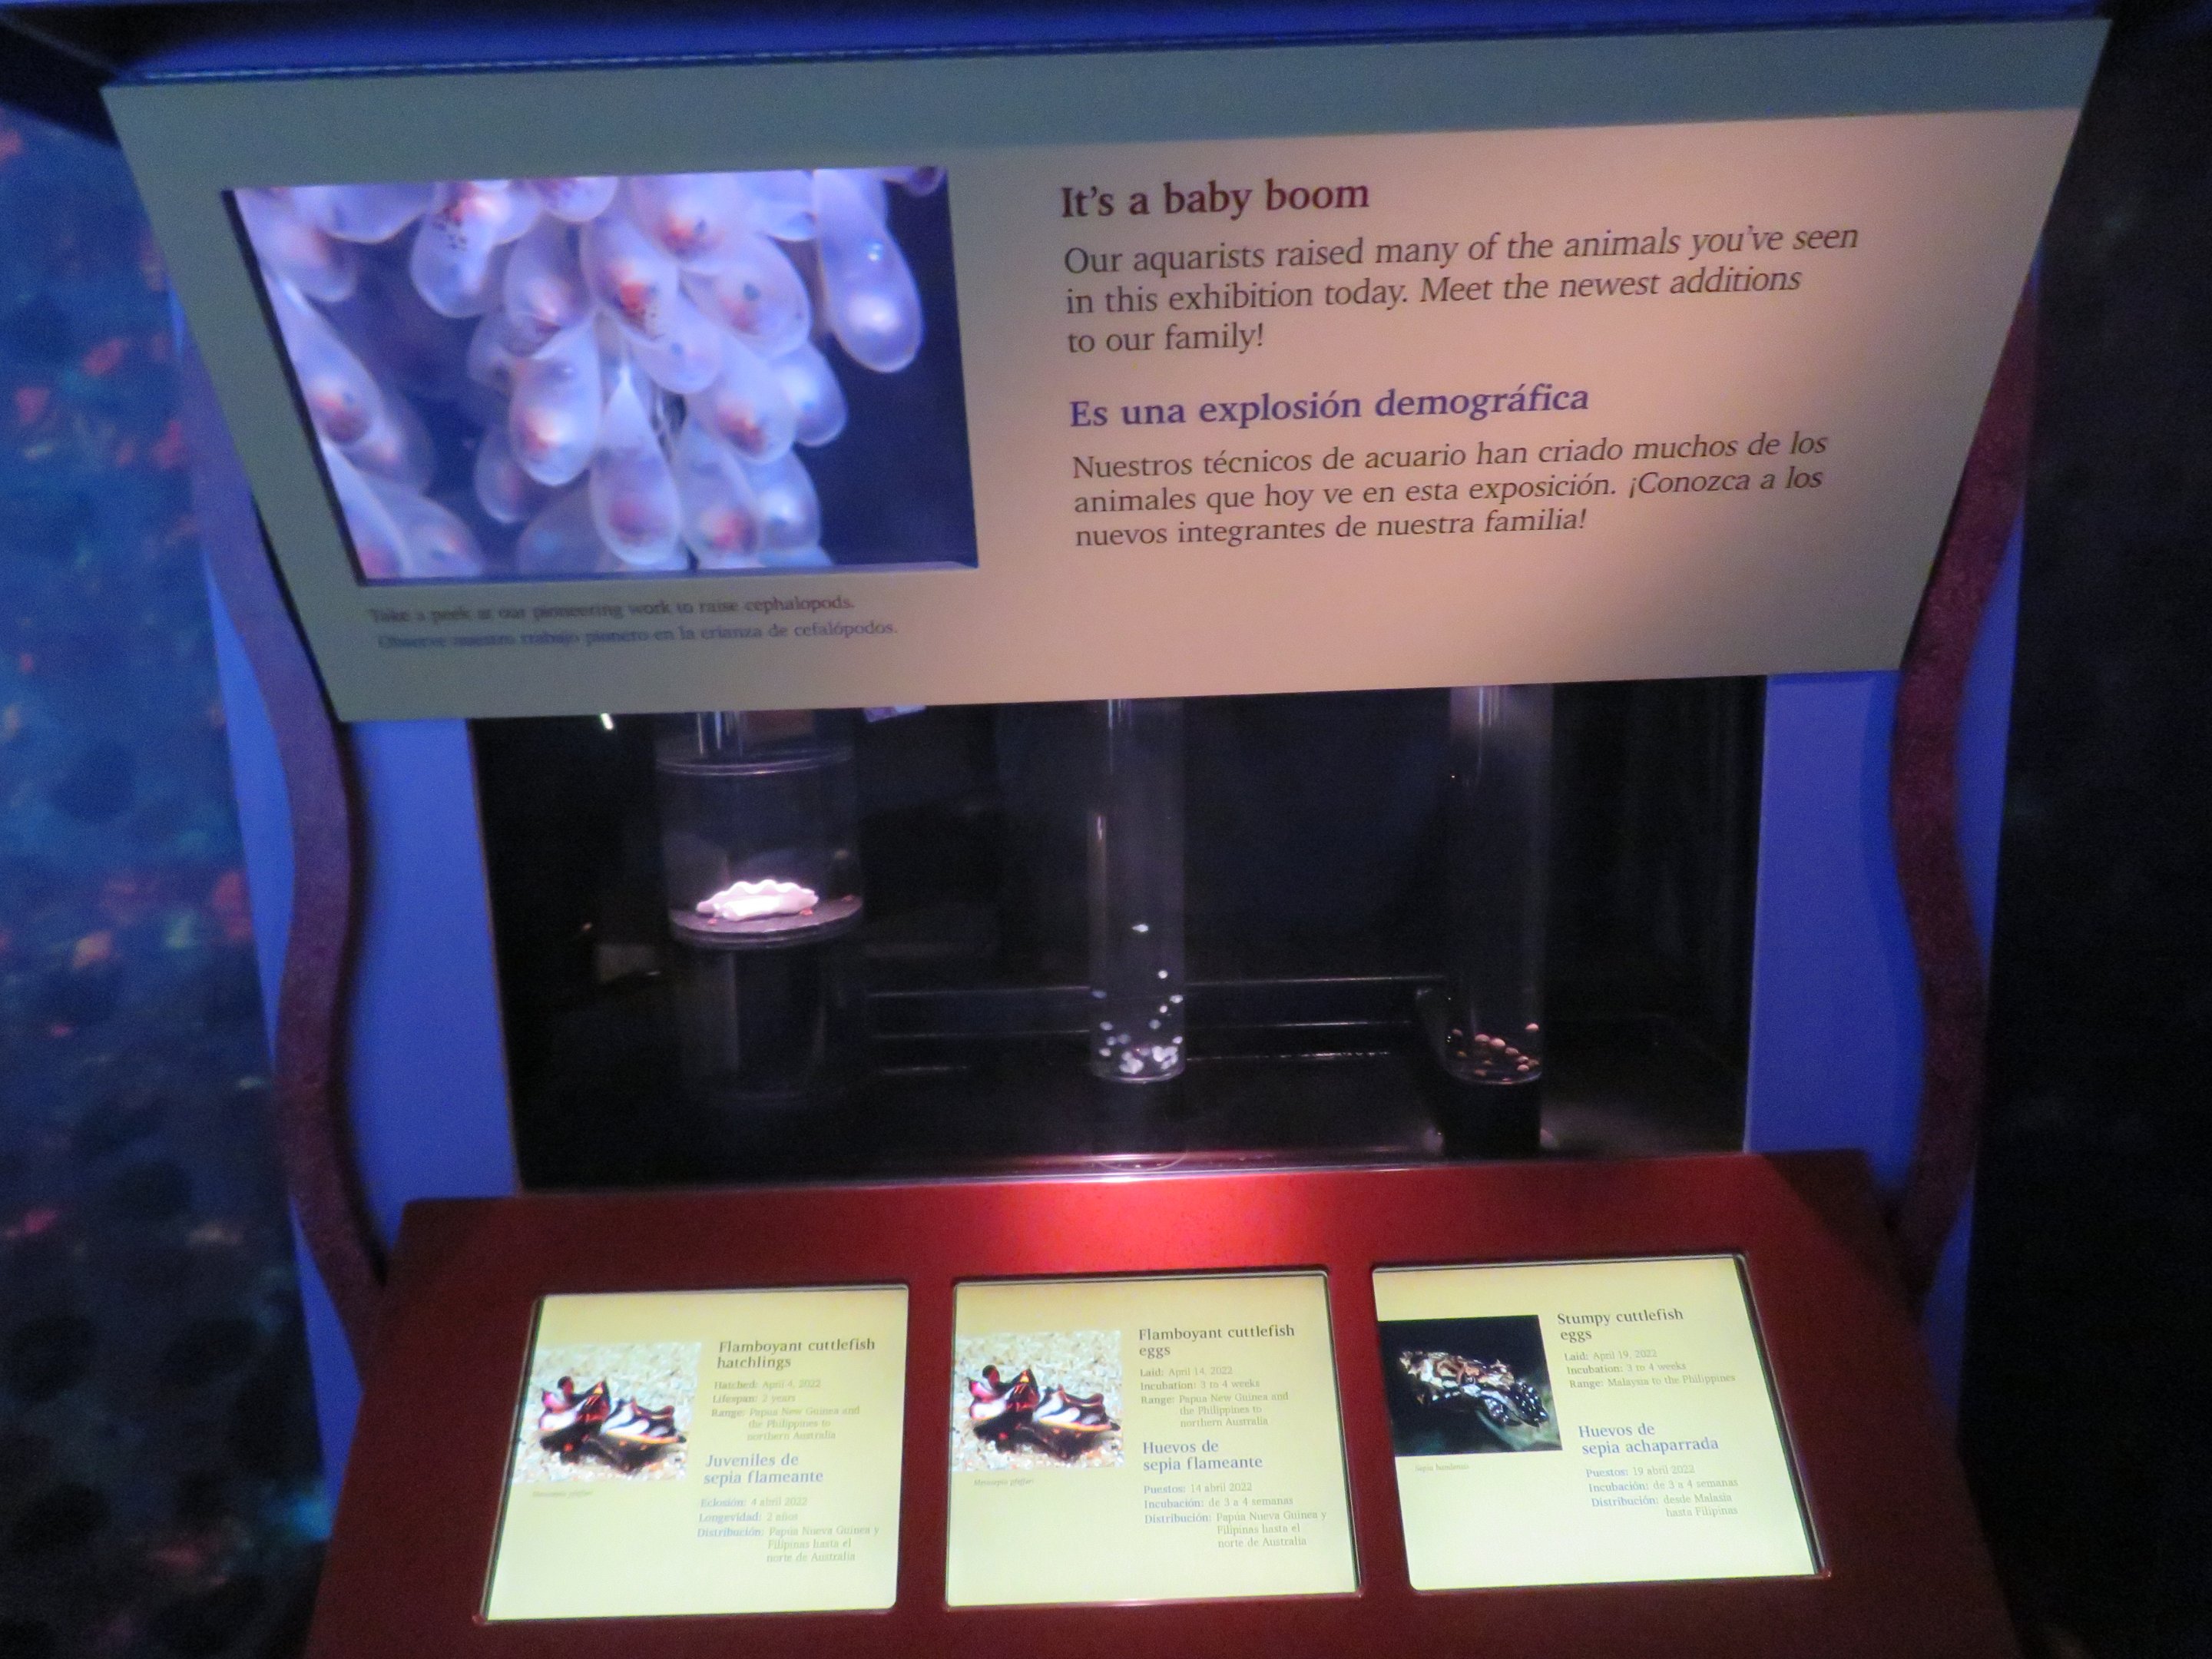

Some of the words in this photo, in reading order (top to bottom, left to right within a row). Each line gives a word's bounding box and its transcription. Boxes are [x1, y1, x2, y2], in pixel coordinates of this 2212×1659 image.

[1128, 192, 1150, 216] a
[1163, 179, 1253, 221] baby
[1266, 177, 1369, 210] boom
[1063, 246, 1124, 274] Our
[1132, 241, 1265, 283] aquarists
[1275, 236, 1364, 267] raised
[1374, 241, 1459, 270] many
[1467, 230, 1502, 261] of
[1506, 230, 1554, 260] the
[1562, 226, 1681, 258] animals
[1792, 228, 1859, 250] seen
[1066, 287, 1094, 314] in
[1104, 285, 1158, 313] this
[1167, 280, 1313, 311] exhibition
[1324, 276, 1408, 311] today.
[1419, 276, 1494, 303] Meet
[1502, 271, 1549, 300] the
[1558, 273, 1661, 298] newest
[1668, 265, 1803, 295] additions
[1067, 332, 1096, 353] to
[1104, 332, 1155, 352] our
[1164, 320, 1263, 355] family!
[1071, 400, 1108, 427] Es
[1121, 403, 1186, 426] una
[1197, 389, 1362, 429] explosión
[1374, 382, 1588, 422] demográfica
[1071, 455, 1193, 479] Nuestros
[1202, 449, 1312, 475] técnicos
[1321, 445, 1355, 471] de
[1363, 442, 1467, 469] acuario
[1475, 440, 1528, 465] han
[1537, 436, 1624, 463] criado
[1631, 433, 1738, 460] muchos
[1746, 431, 1781, 456] de
[1789, 429, 1829, 455] los
[1073, 485, 1197, 513] animales
[1205, 490, 1255, 515] que
[1264, 482, 1315, 512] hoy
[1322, 487, 1353, 505] ve
[1362, 485, 1395, 504] en
[1404, 482, 1458, 502] esta
[1468, 472, 1616, 505] exposición.
[1628, 470, 1751, 499] ¡Conozca
[1759, 472, 1776, 490] a
[1784, 465, 1823, 489] los
[1075, 527, 1167, 547] nuevos
[1177, 520, 1326, 548] integrantes
[1334, 514, 1367, 538] de
[1376, 516, 1474, 537] nuestra
[1484, 507, 1587, 533] familia!
[1557, 1313, 1610, 1327] Stumpy
[1616, 1308, 1684, 1323] cuttlefish
[1139, 1327, 1222, 1343] Flamboyant
[1227, 1324, 1295, 1338] cuttlefish
[1560, 1330, 1593, 1343] eggs
[719, 1340, 803, 1355] Flamboyant
[808, 1337, 876, 1351] cuttlefish
[1138, 1346, 1171, 1359] eggs
[717, 1356, 792, 1371] hatchlings
[1578, 1425, 1633, 1439] Huevos
[1637, 1422, 1655, 1435] de
[1143, 1442, 1197, 1455] Huevos
[1201, 1439, 1219, 1452] de
[1581, 1441, 1621, 1457] sepia
[1625, 1436, 1720, 1455] achaparrada
[706, 1453, 776, 1468] Juveniles
[780, 1452, 799, 1466] de
[1143, 1457, 1181, 1473] sepia
[1187, 1456, 1263, 1470] flameante
[704, 1471, 742, 1487] sepia
[747, 1470, 824, 1484] flameante
